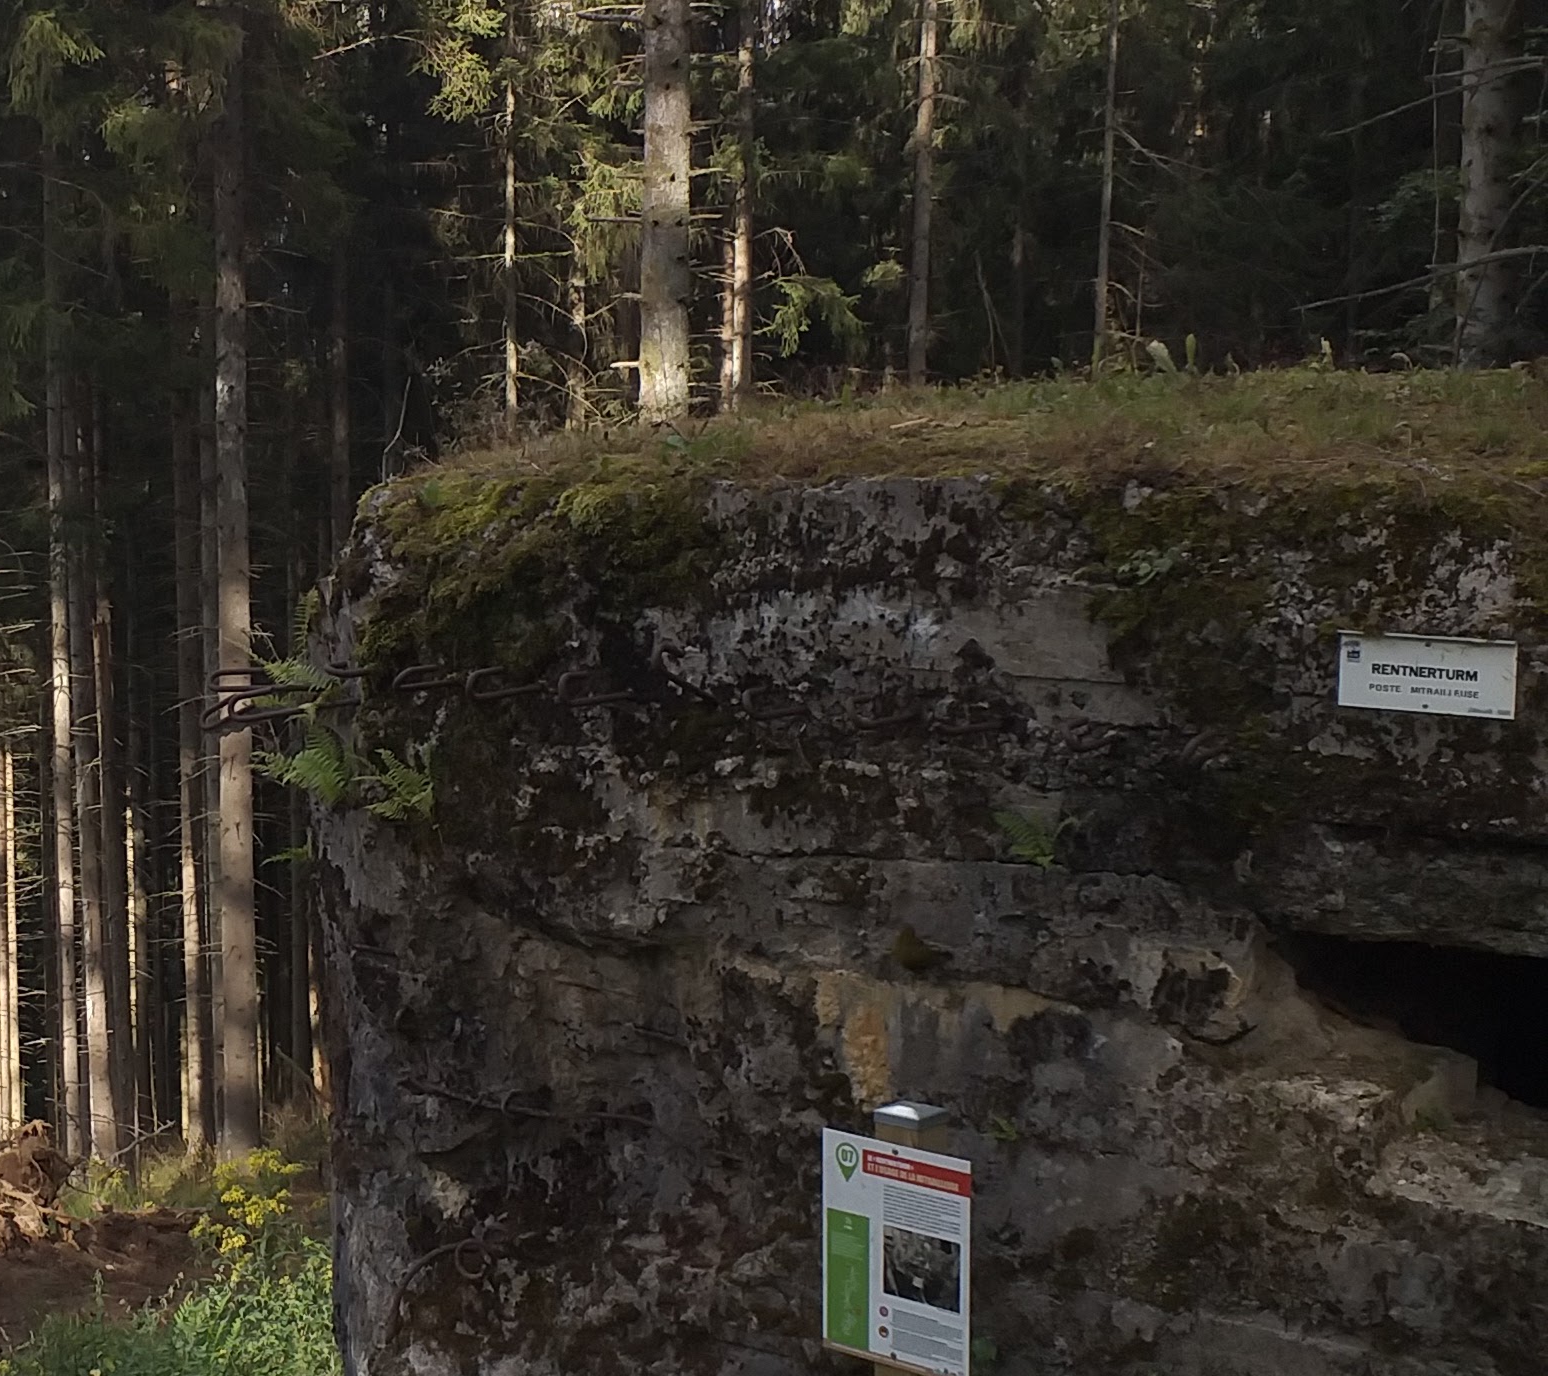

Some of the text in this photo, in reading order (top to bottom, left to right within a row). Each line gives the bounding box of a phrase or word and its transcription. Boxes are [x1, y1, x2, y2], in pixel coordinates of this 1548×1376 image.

[1371, 663, 1478, 682] RENTNERTURM
[1369, 684, 1401, 693] POSTE
[842, 1149, 854, 1163] 07
